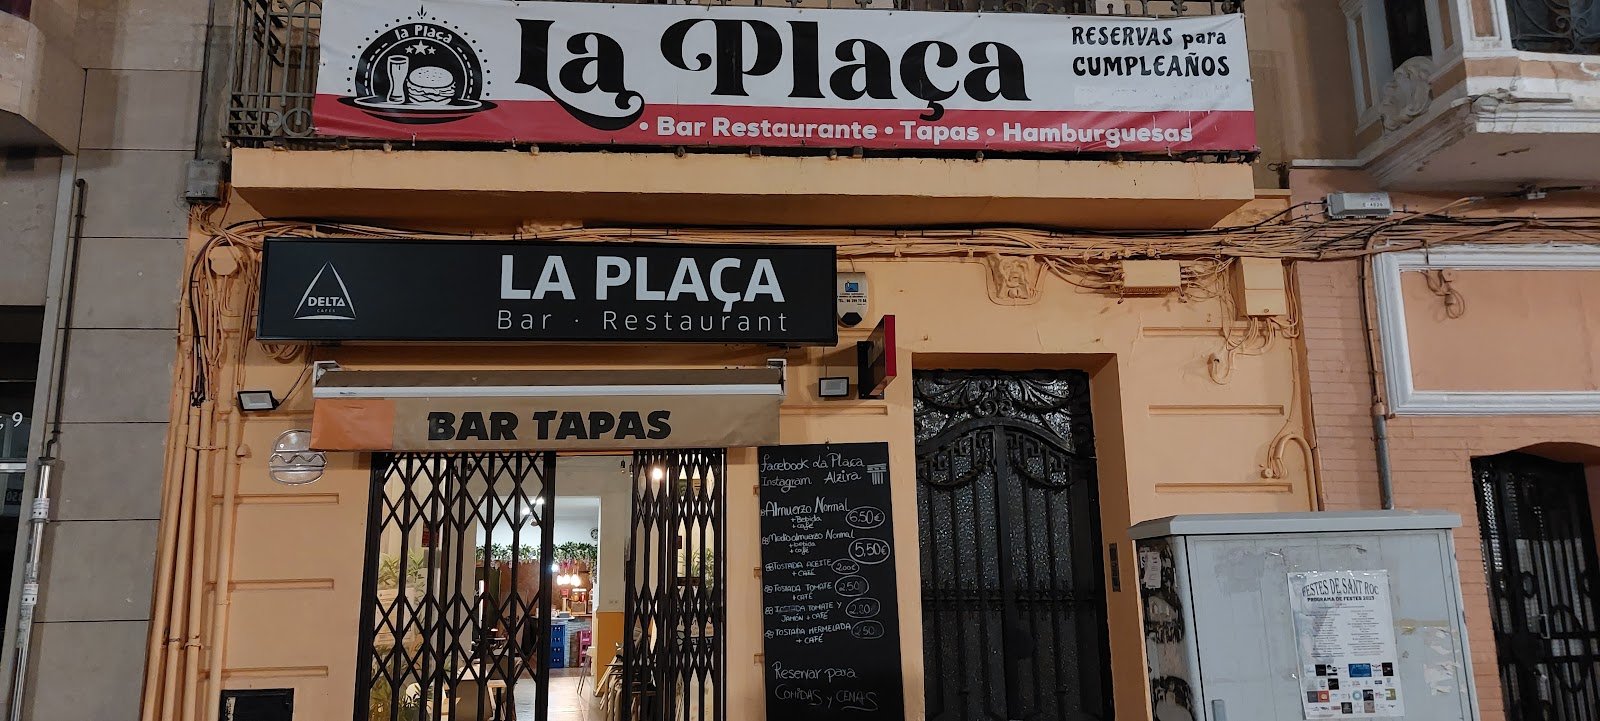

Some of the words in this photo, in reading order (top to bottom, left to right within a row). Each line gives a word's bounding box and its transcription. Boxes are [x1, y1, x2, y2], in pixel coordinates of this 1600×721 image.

[395, 28, 409, 40] la
[414, 24, 453, 44] Plaça
[1072, 26, 1173, 46] RESERVAS
[1182, 31, 1227, 50] para
[515, 18, 645, 131] La
[660, 18, 1032, 122] Plaça
[1072, 52, 1230, 77] CUMPLEAÑOS
[657, 116, 706, 137] Bar
[712, 117, 877, 140] Restaurante
[900, 121, 980, 145] Tapas
[1003, 122, 1193, 148] Hamburguesas
[500, 254, 576, 300] LA
[596, 255, 786, 312] PLAÇA
[308, 296, 346, 307] DELTA
[497, 309, 552, 330] Bar
[602, 310, 788, 331] Restaurant
[12, 411, 23, 428] 9
[427, 411, 519, 441] BAR
[532, 410, 672, 440] TAPAS
[762, 476, 812, 494] Instagram
[824, 470, 862, 484] Alzira
[766, 500, 812, 516] Almuerzo
[814, 496, 850, 512] Normal
[826, 530, 856, 540] Normal
[1302, 580, 1328, 596] FESTES
[1330, 578, 1340, 594] DE
[1342, 578, 1362, 594] SANT
[1364, 582, 1380, 594] ROC
[808, 602, 834, 610] TOMATE
[776, 628, 806, 636] TOSTADA
[808, 622, 852, 634] MERMELADA
[804, 634, 824, 644] CAFÉ
[772, 660, 822, 680] Reservar
[824, 668, 856, 684] para
[836, 690, 878, 712] CENAS
